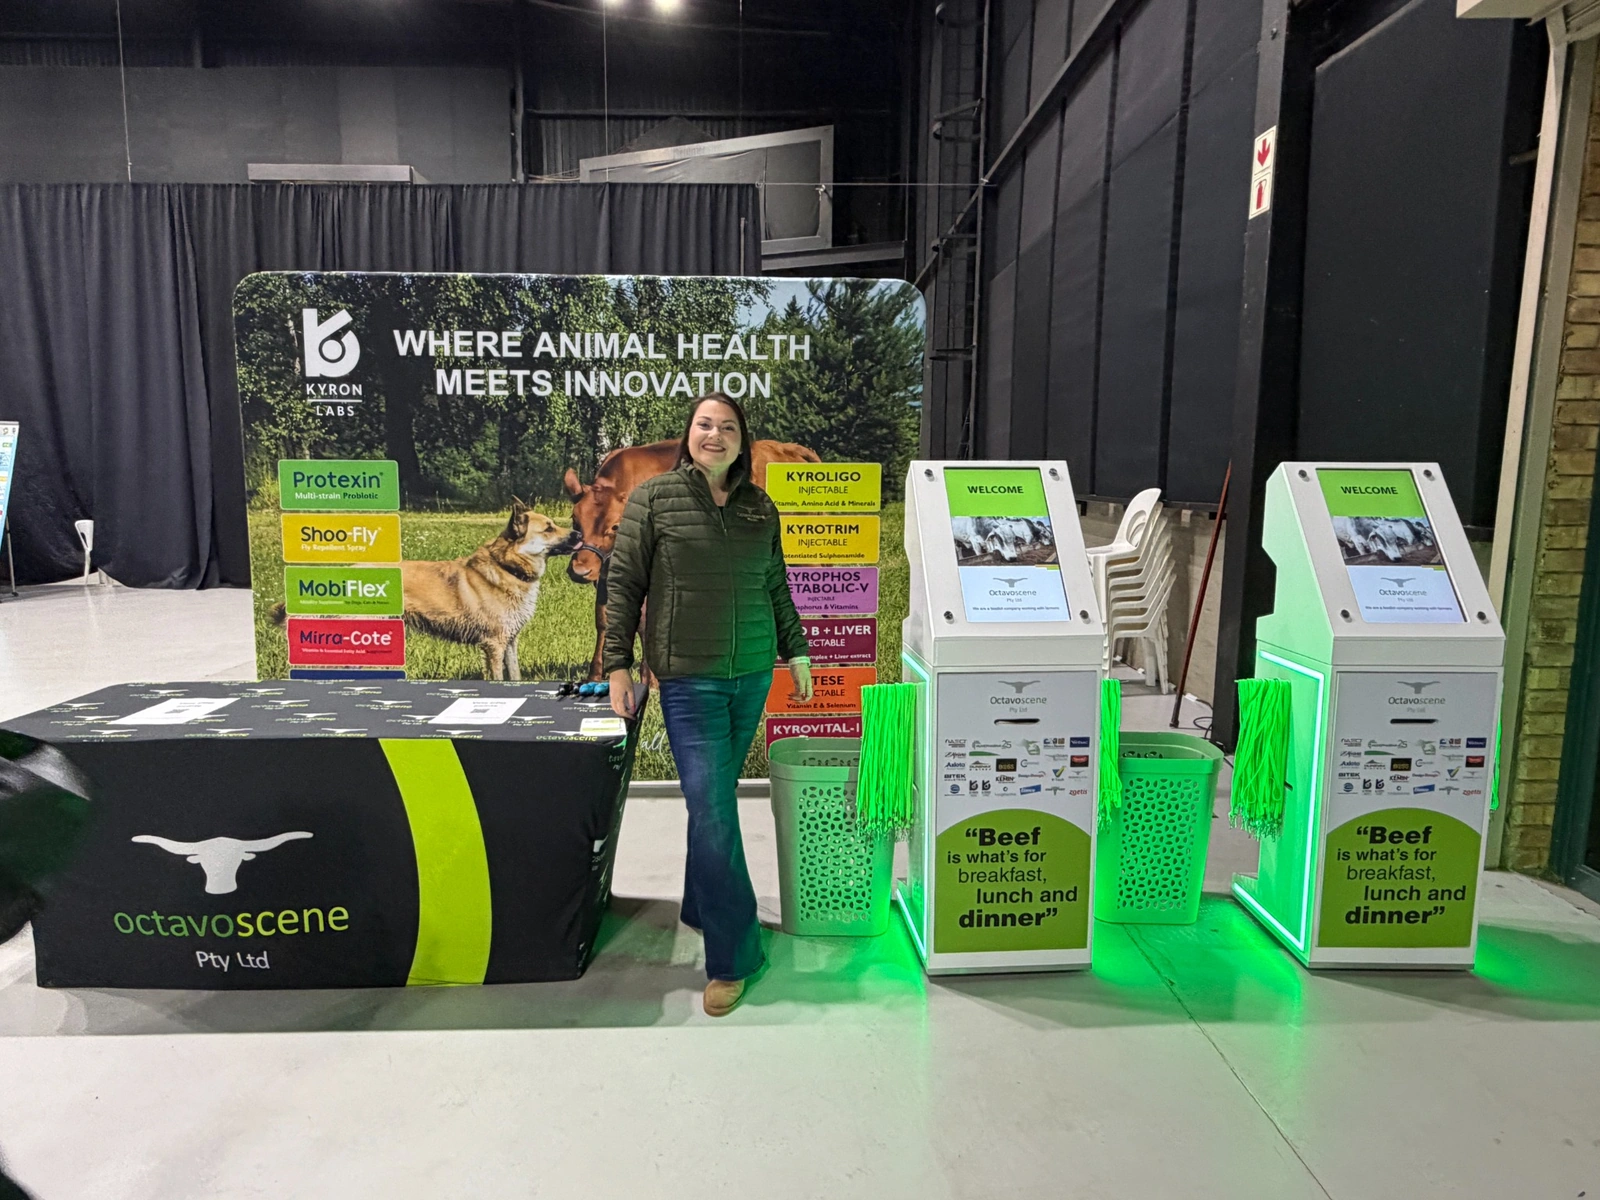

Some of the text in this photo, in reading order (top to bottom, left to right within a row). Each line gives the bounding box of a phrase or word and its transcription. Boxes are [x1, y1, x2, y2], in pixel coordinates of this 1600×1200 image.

[393, 329, 811, 361] WHERE ANIMAL HEALTH
[306, 383, 363, 396] KYRON
[436, 369, 771, 398] MEETS INNOVATION
[316, 405, 355, 417] LABS
[293, 471, 381, 488] Protexin
[786, 471, 861, 482] KYROLIGO
[295, 492, 379, 500] Multi-strain Probiotic
[798, 485, 849, 495] INJECTABLE
[967, 485, 1024, 494] WELCOME
[1340, 485, 1399, 495] WELCOME
[300, 525, 379, 547] Shoo-Fly
[786, 524, 860, 535] KYROTRIM
[798, 538, 848, 548] INJECTABLE
[298, 579, 388, 598] MobiFlex
[789, 583, 869, 594] ETABOLIC-V
[811, 626, 820, 636] B
[834, 625, 872, 635] LIVER
[300, 631, 391, 646] Mirra-Cote
[808, 638, 846, 647] ECTABLE
[989, 696, 1048, 705] Octavoscene
[1388, 696, 1446, 705] Octavoscene
[965, 827, 1041, 847] “Beef
[1356, 825, 1433, 845] “Beef
[947, 849, 1047, 864] is what’s for
[1337, 848, 1437, 861] is what’s for
[958, 867, 1047, 884] breakfast,
[1346, 865, 1436, 882] breakfast,
[976, 886, 1078, 904] lunch and
[1364, 885, 1467, 901] lunch and
[113, 906, 350, 938] octavoscene
[958, 907, 1058, 928] dinner”
[1345, 906, 1446, 925] dinner”
[195, 951, 271, 972] Pty Ltd
